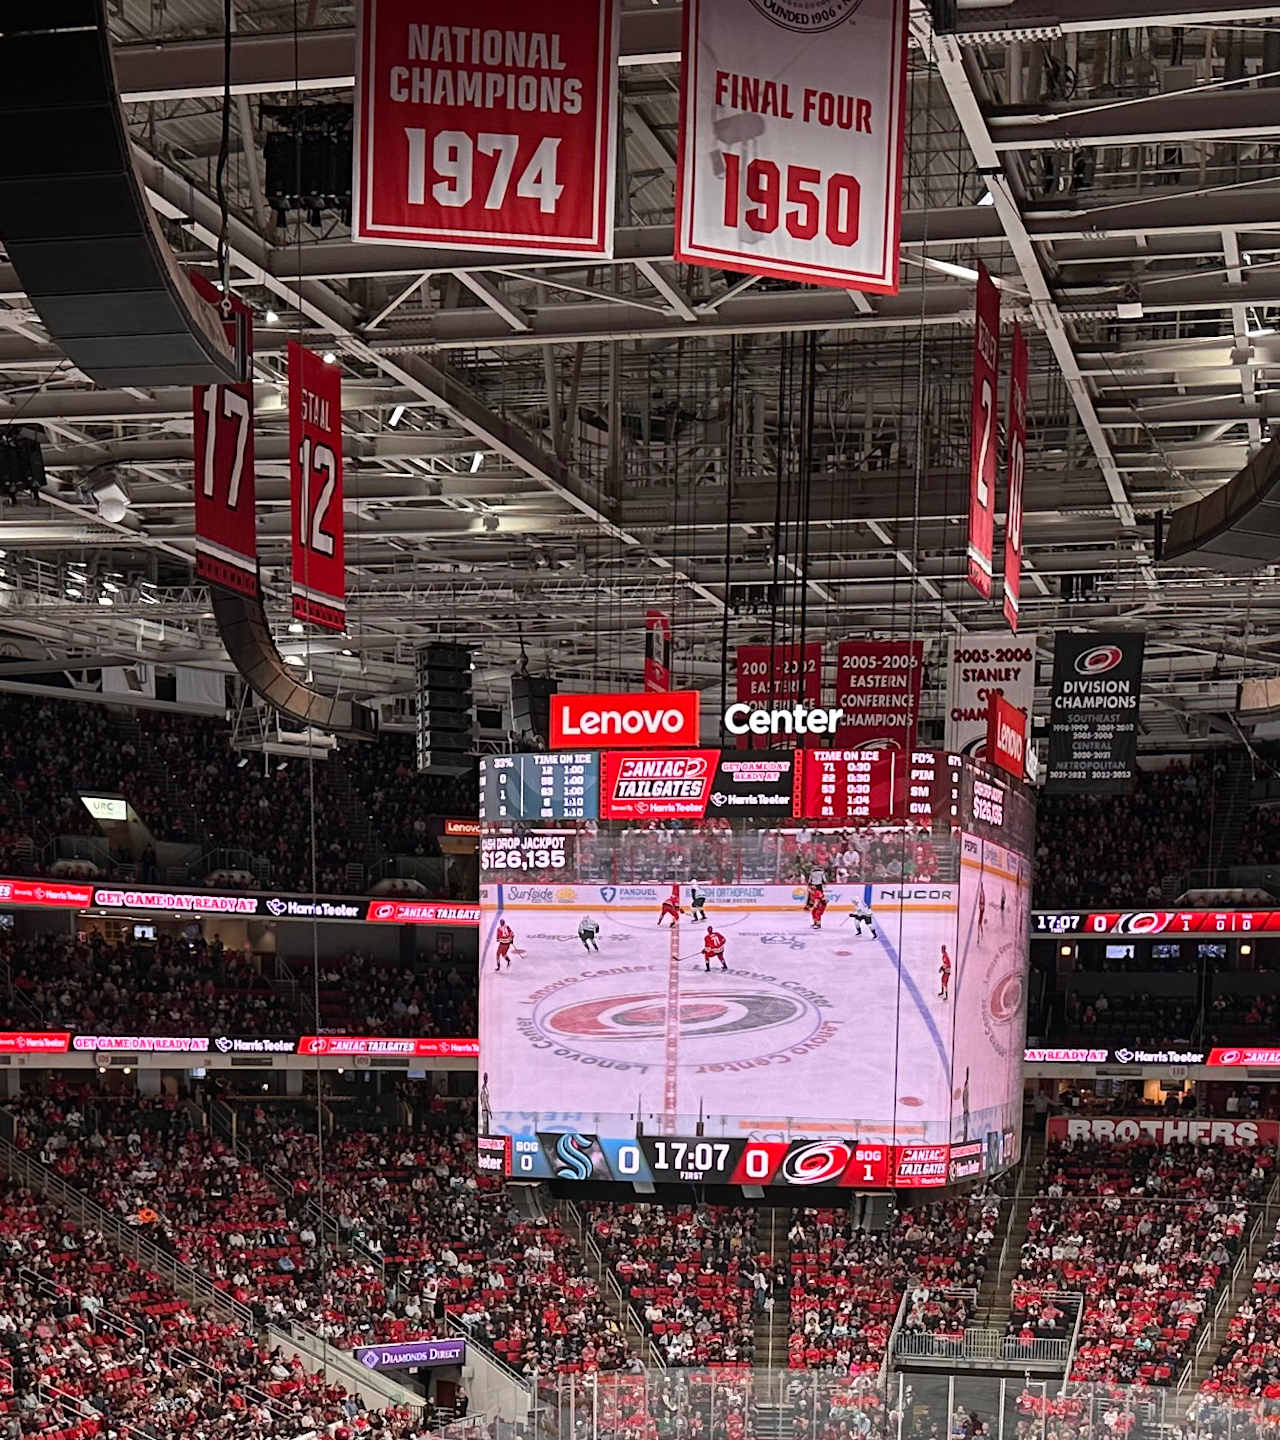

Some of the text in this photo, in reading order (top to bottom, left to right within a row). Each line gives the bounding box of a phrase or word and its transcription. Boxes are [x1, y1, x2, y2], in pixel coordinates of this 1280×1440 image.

[408, 23, 567, 71] NATIONAL
[389, 66, 582, 115] CHAMPIONS
[715, 70, 873, 134] FINAL FOUR
[404, 127, 564, 214] 1974
[720, 153, 861, 248] 1950
[301, 388, 331, 433] STAAL
[203, 384, 249, 509] 17
[299, 435, 335, 558] 12
[842, 656, 918, 669] 2005-2006
[954, 648, 1032, 663] 2005-2006
[850, 675, 907, 688] EASTERN
[962, 669, 1021, 682] STANLEY
[1063, 681, 1130, 693] DIVISION
[840, 695, 914, 707] CONFERENCE
[1055, 696, 1136, 708] CHAMPIONS
[562, 705, 684, 735] Lenovo
[724, 703, 844, 734] Center
[840, 714, 913, 726] CHAMPIONS
[1068, 714, 1120, 722] SOUTHEAST
[997, 712, 1022, 761] Lenovo
[1072, 742, 1112, 750] CENTRAL
[814, 751, 879, 761] TIME ON ICE
[622, 760, 684, 778] CANIAC
[1056, 761, 1126, 769] METROPOLITAN
[618, 781, 703, 796] TAILGATES
[728, 795, 790, 804] Harris Teeter
[481, 850, 566, 870] $126,135
[508, 886, 553, 900] Surfside
[881, 890, 951, 900] NUCOR
[1037, 915, 1079, 930] 17:07
[1094, 916, 1106, 932] 0
[233, 1037, 295, 1052] Harris Teeter
[1134, 1051, 1204, 1063] Harris Teeter
[1067, 1119, 1259, 1146] BROTHERS
[516, 1143, 538, 1152] SOG
[619, 1147, 639, 1173] 0
[655, 1142, 730, 1170] 17:07
[746, 1150, 768, 1177] 0
[856, 1151, 881, 1161] SOG
[680, 1172, 703, 1180] FIRST
[900, 1163, 946, 1176] TAILGATES
[382, 1347, 460, 1365] DIAMONDS DIRECT
